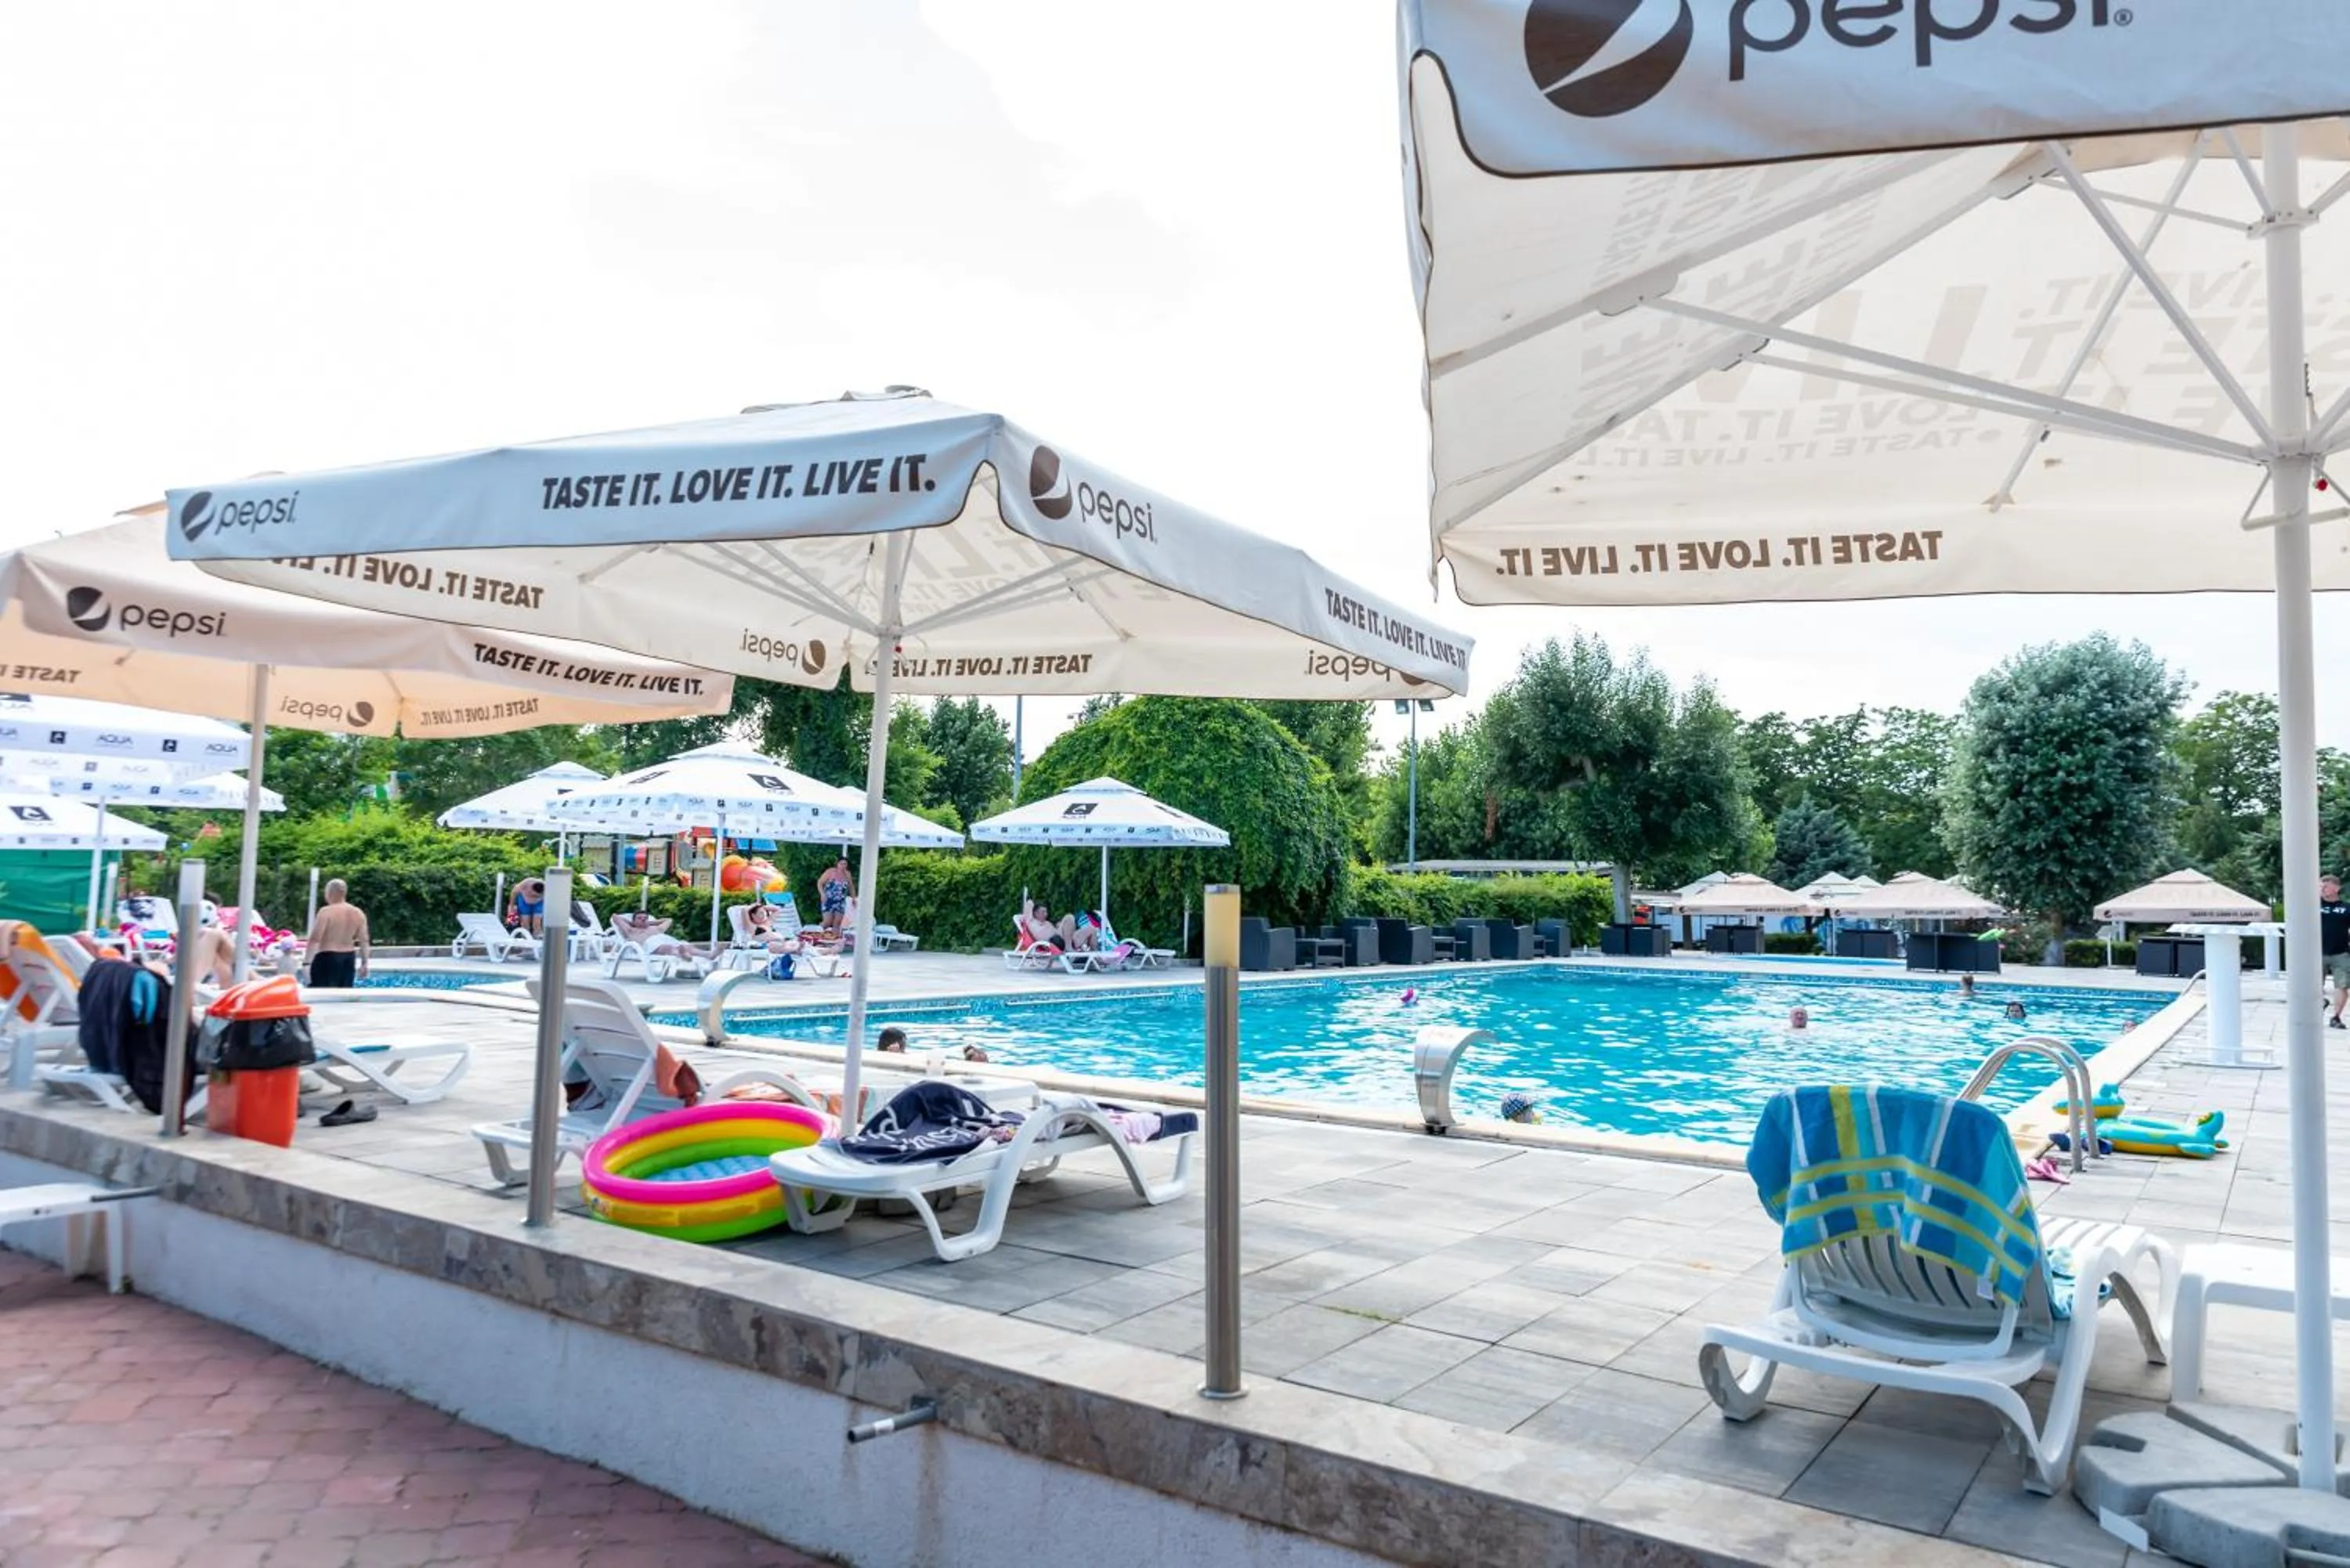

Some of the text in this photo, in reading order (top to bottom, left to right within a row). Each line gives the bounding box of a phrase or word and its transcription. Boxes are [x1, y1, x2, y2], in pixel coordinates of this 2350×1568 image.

[543, 454, 935, 509] TASTE IT. LOVE IT. LIVE IT.
[214, 490, 299, 535] pepsi
[1079, 482, 1154, 542] pepsi
[120, 605, 226, 638] pepsi
[1325, 588, 1365, 630] TASTE
[1368, 608, 1383, 638] IT.
[1384, 616, 1412, 652] LOVE
[1415, 632, 1429, 656] IT.
[1430, 636, 1456, 666] LIVE
[474, 644, 703, 695] TASTE IT. LOVE IT. LIVE IT.
[97, 734, 133, 744] AQUA
[205, 743, 237, 753] AQUA
